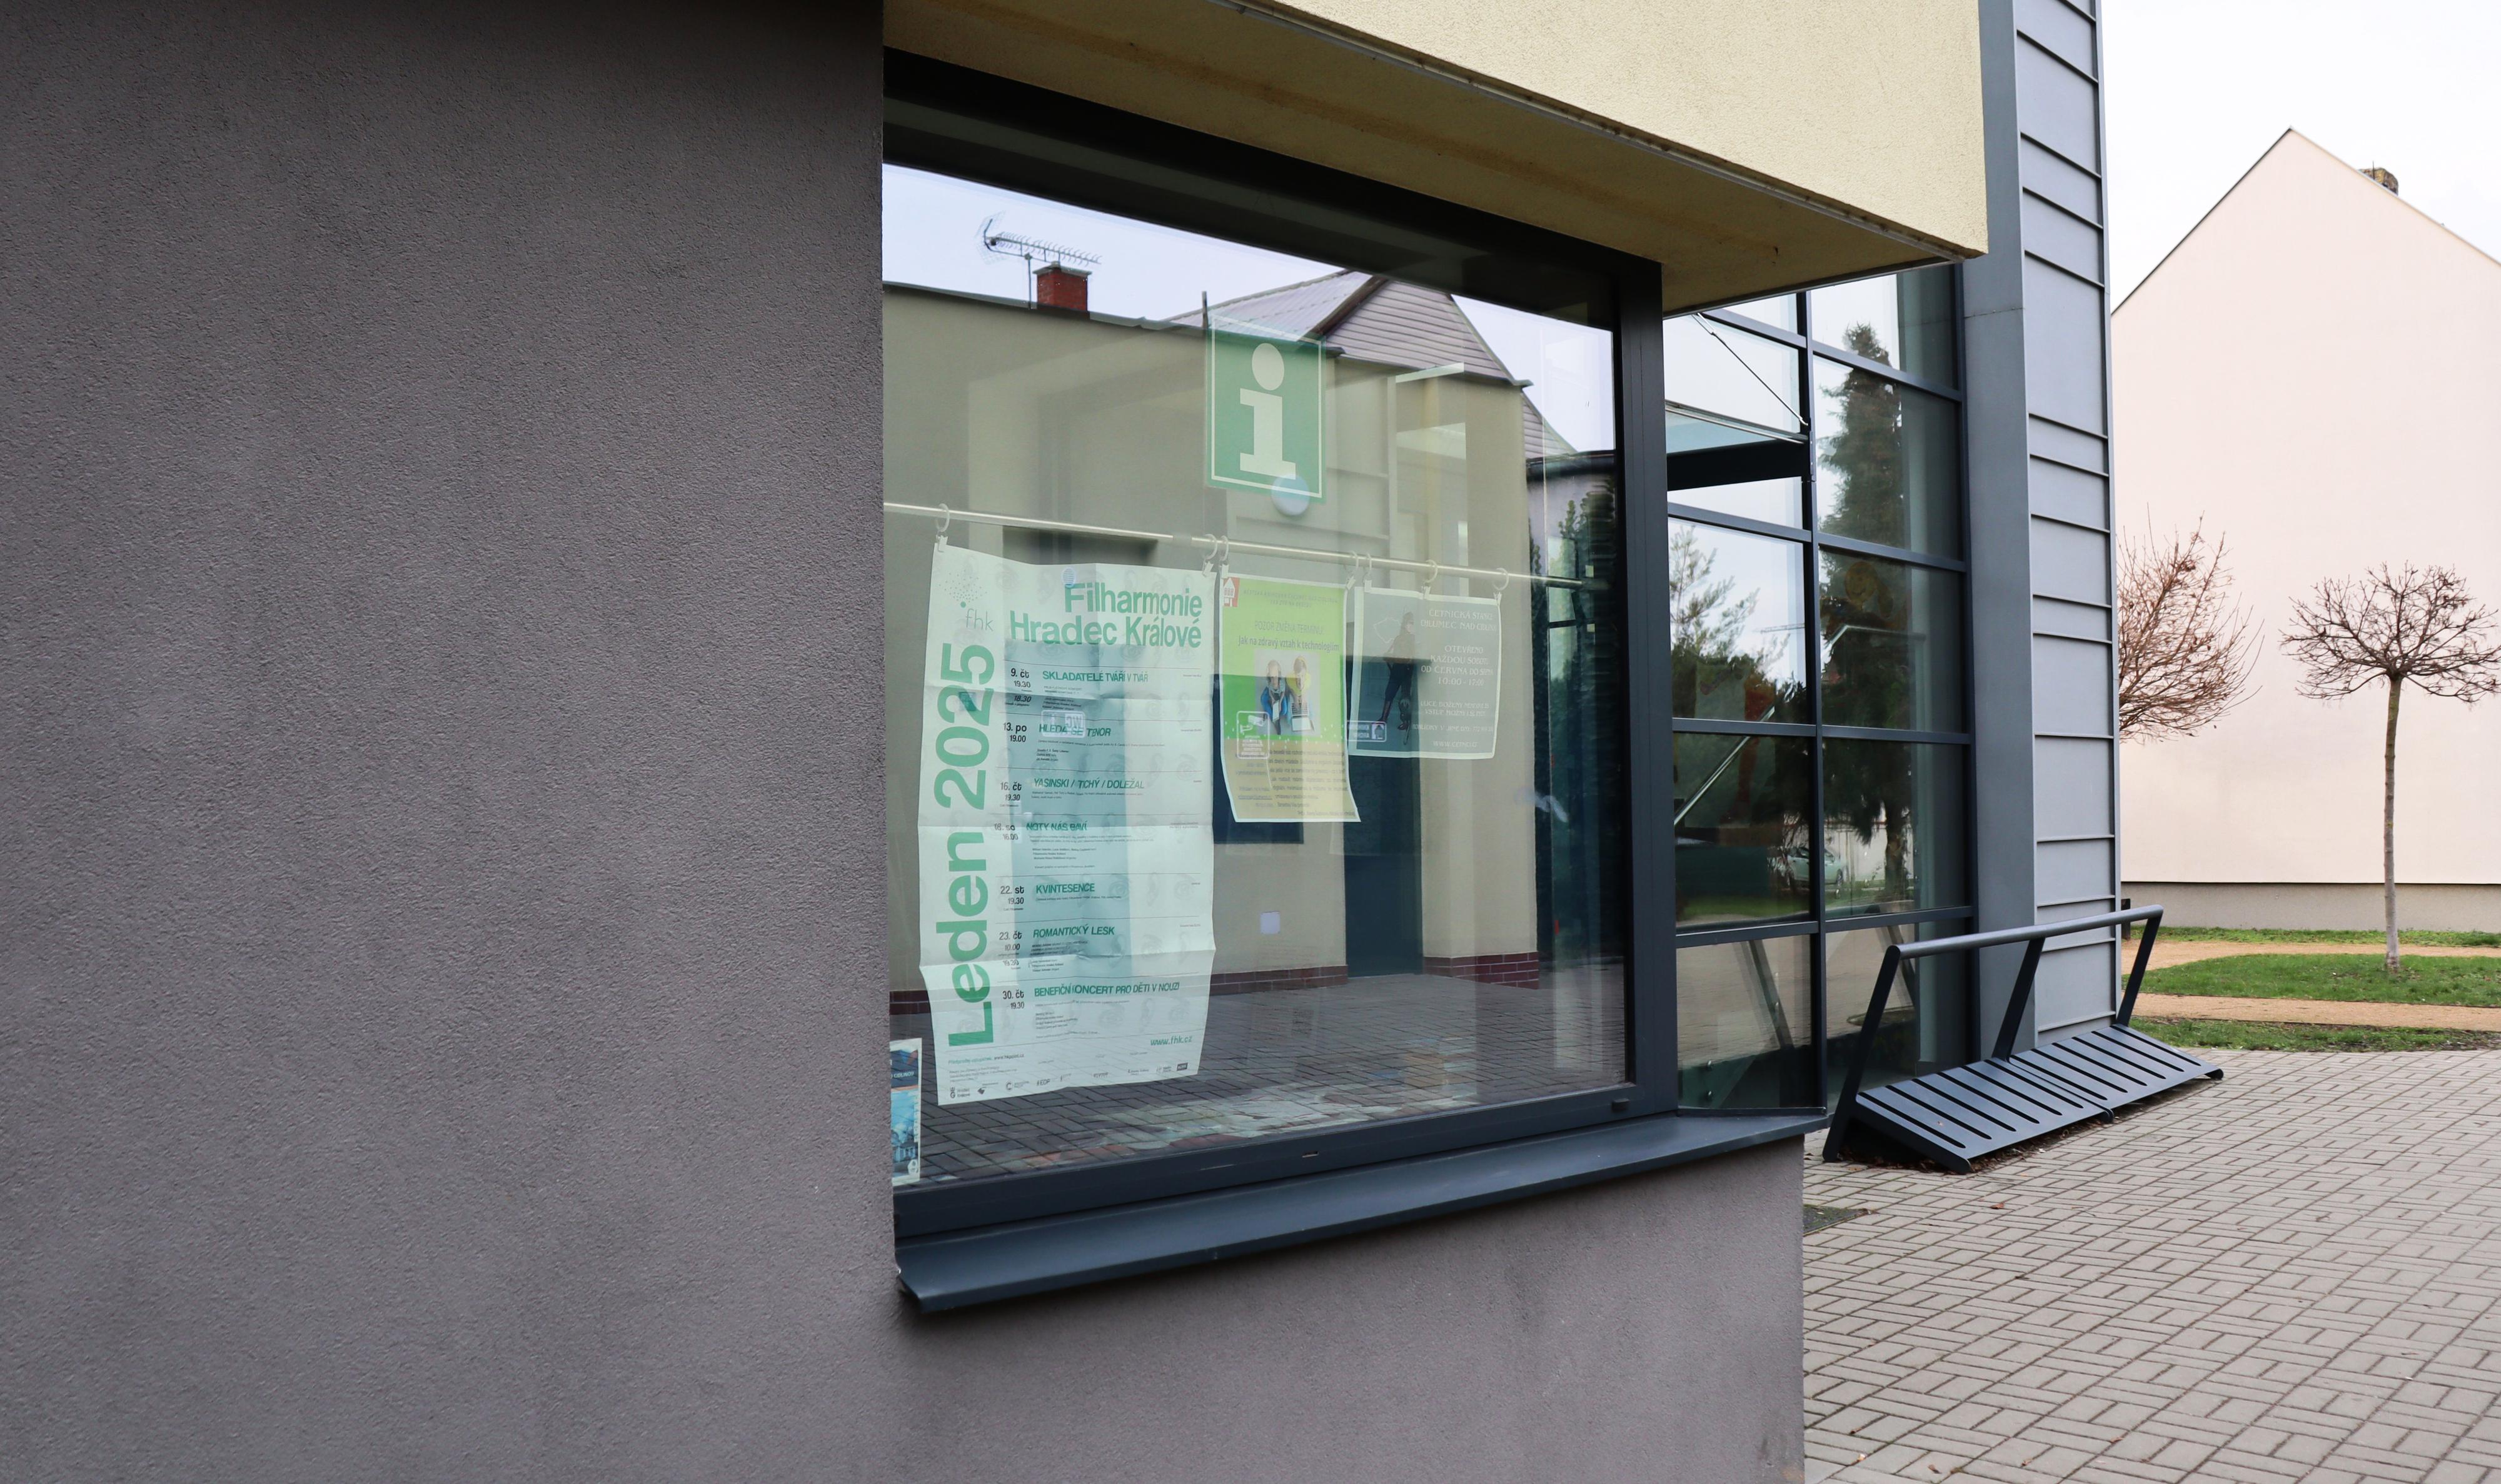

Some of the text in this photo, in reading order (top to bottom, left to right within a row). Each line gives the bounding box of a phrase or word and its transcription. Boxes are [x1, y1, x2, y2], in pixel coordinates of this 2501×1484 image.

[1064, 582, 1203, 617] Filharmonie
[965, 608, 994, 631] fhk
[1009, 610, 1202, 648] Hradec Králové
[1459, 621, 1476, 631] NAD
[1239, 635, 1339, 653] Jak na zdravý vztah k technologiím
[1430, 654, 1466, 664] KAŽDOU
[1421, 664, 1432, 673] OD
[1010, 668, 1149, 683] 9. čt SKLADATELÉ TVÁŘÍ V TVÁŘ
[1014, 680, 1031, 688] 19.30
[1014, 694, 1032, 703] 18.30
[933, 643, 995, 810] 2025
[1004, 722, 1014, 731] 13.
[1015, 724, 1027, 734] po
[1087, 728, 1111, 737] TENOR
[1010, 734, 1027, 743] 19.00
[1000, 782, 1010, 791] 16.
[1012, 781, 1022, 791] čt
[1034, 778, 1069, 788] YASINSKI
[1078, 776, 1100, 789] TICHÝ
[1107, 778, 1145, 789] DOLEŽAL
[1026, 822, 1050, 831] NOTY
[1051, 820, 1069, 831] NÁS
[1070, 820, 1088, 831] BAVÍ
[1000, 883, 1095, 895] 22. st KVINTESENCE
[1008, 897, 1024, 905] 19.30
[999, 923, 1115, 940] 23. čt ROMANTICKÝ LESK
[936, 831, 994, 1047] Leden
[1004, 943, 1020, 951] 10.00
[1002, 990, 1014, 999] 30.
[1015, 989, 1025, 999] čt
[1034, 983, 1072, 997] BENEFIČNÍ
[1115, 985, 1132, 995] PRO
[1133, 981, 1150, 993] DĚTI
[1152, 983, 1157, 992] V
[1010, 1001, 1025, 1010] 19.30
[1150, 1035, 1193, 1046] www.fhk.cz
